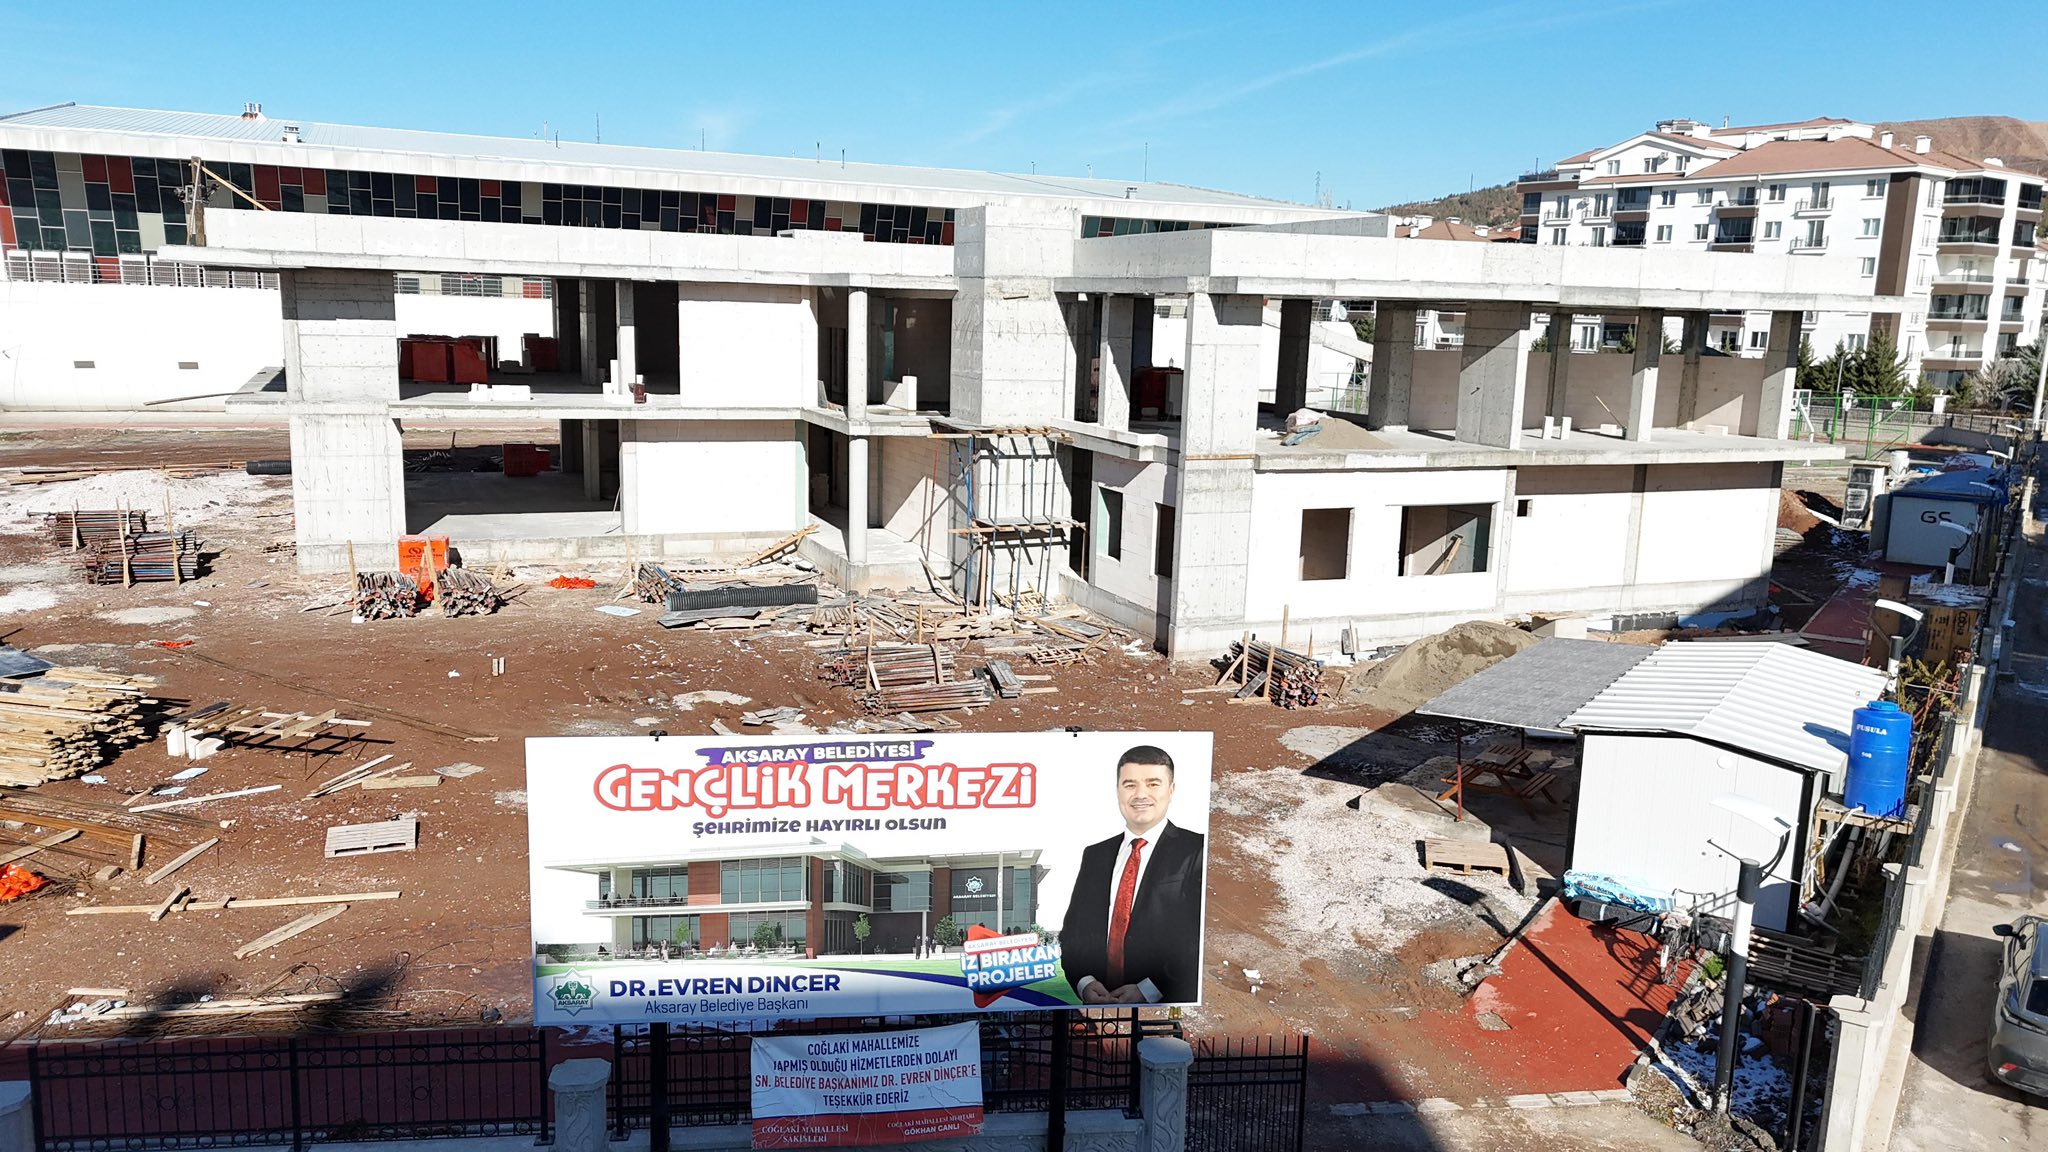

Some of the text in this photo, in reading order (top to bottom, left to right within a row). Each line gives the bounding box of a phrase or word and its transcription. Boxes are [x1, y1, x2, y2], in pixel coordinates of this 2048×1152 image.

[721, 741, 915, 764] AKSARAY BELEDİYESİ
[594, 761, 1037, 818] GENÇLİK MERKEZİ
[806, 818, 880, 832] HAYIRLI
[960, 944, 1061, 971] İZ BIRAKAN
[748, 974, 841, 993] DİNÇER
[967, 963, 1056, 987] PROJELER
[645, 997, 808, 1015] Aksaray Belediye Başkanı
[852, 1034, 919, 1053] MAHALLEMİZE
[810, 1056, 848, 1072] OLDUĞU
[850, 1053, 923, 1071] HİZMETLERDEN
[925, 1048, 958, 1065] DOLAYI
[755, 1064, 976, 1092] SN. BELEDİYE BAŞKANIMIZ DR. EVREN DİNÇER'E
[823, 1089, 909, 1109] TEŞEKKÜR EDERİZ
[783, 1133, 827, 1143] SAKİNLERİ
[904, 1123, 960, 1136] GÖKHAN CANLI
